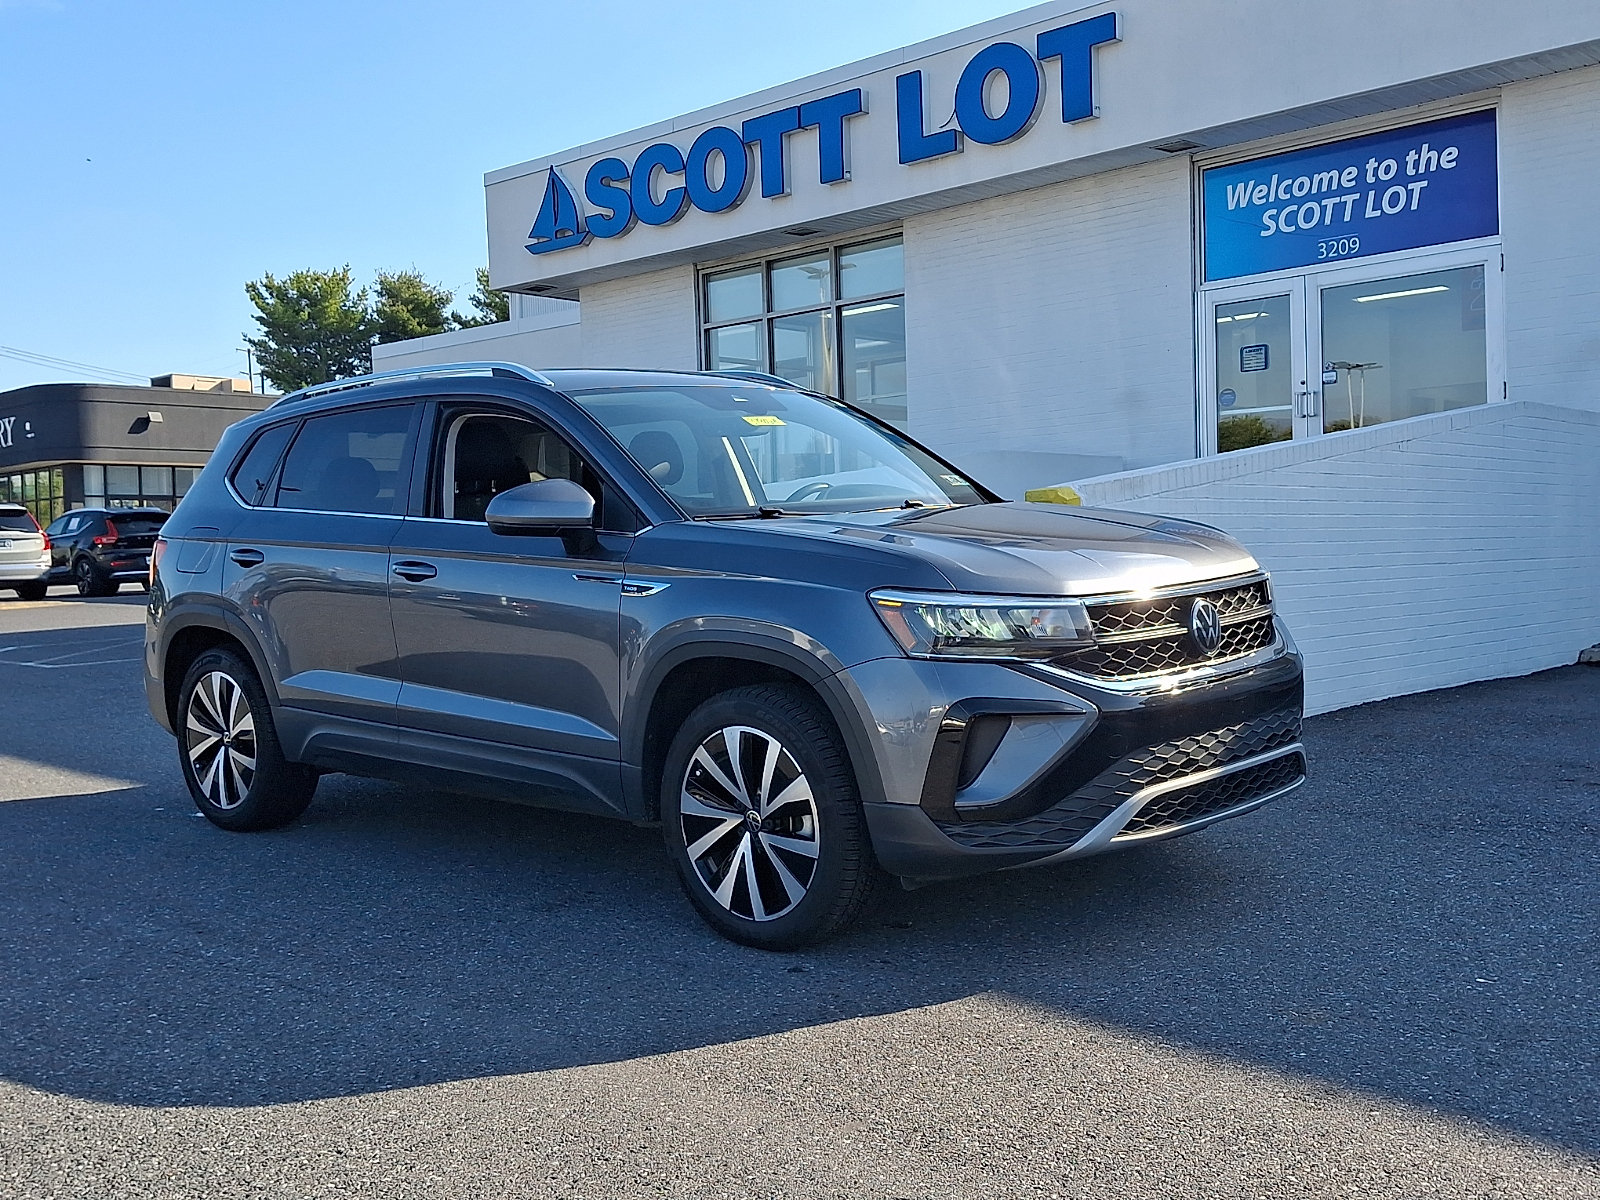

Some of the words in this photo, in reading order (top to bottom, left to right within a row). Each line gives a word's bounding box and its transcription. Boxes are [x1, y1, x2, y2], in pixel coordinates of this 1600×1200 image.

[584, 88, 866, 239] SCOTT
[895, 11, 1121, 165] LOT
[1226, 166, 1358, 210] Welcome
[1365, 157, 1398, 181] to
[1405, 143, 1459, 176] the
[1260, 193, 1361, 237] SCOTT
[1363, 180, 1429, 219] LOT
[1317, 236, 1361, 259] 3209
